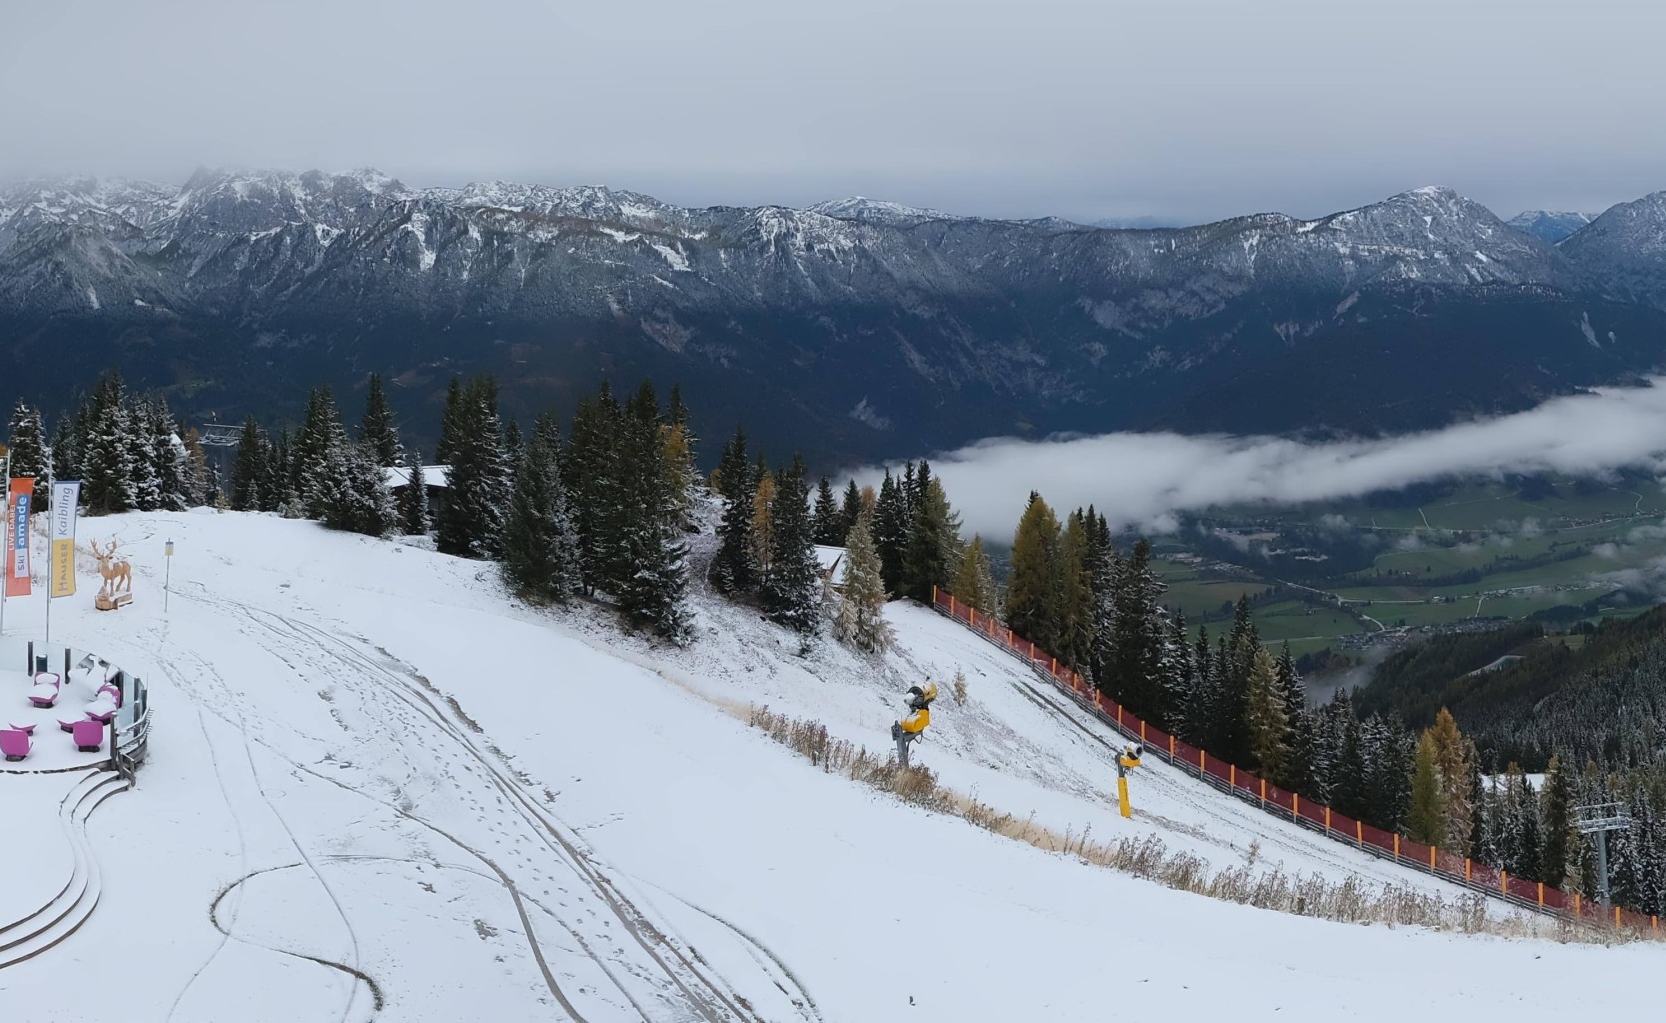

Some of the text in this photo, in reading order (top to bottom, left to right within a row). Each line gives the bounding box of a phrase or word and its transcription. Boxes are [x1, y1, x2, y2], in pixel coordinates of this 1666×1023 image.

[8, 504, 16, 529] DABEI
[58, 487, 74, 591] HAUSER Kaibling
